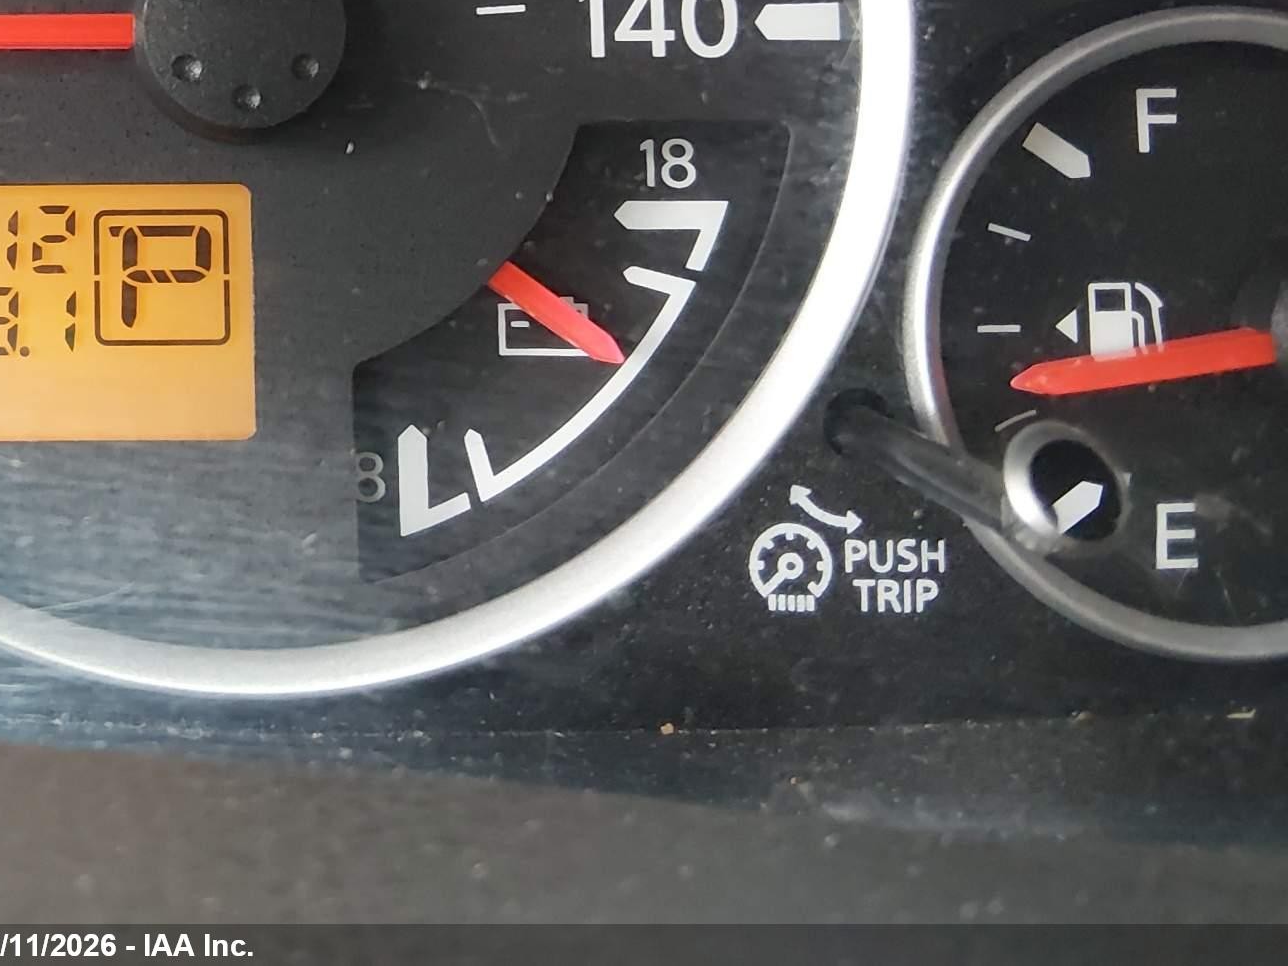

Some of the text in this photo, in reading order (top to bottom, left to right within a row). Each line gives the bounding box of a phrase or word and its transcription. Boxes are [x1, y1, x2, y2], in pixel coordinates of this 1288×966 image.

[1136, 88, 1178, 154] F
[639, 139, 697, 189] 18
[109, 225, 212, 328] P
[844, 539, 945, 574] PUSH
[1155, 503, 1199, 569] E
[852, 579, 939, 613] TRIP
